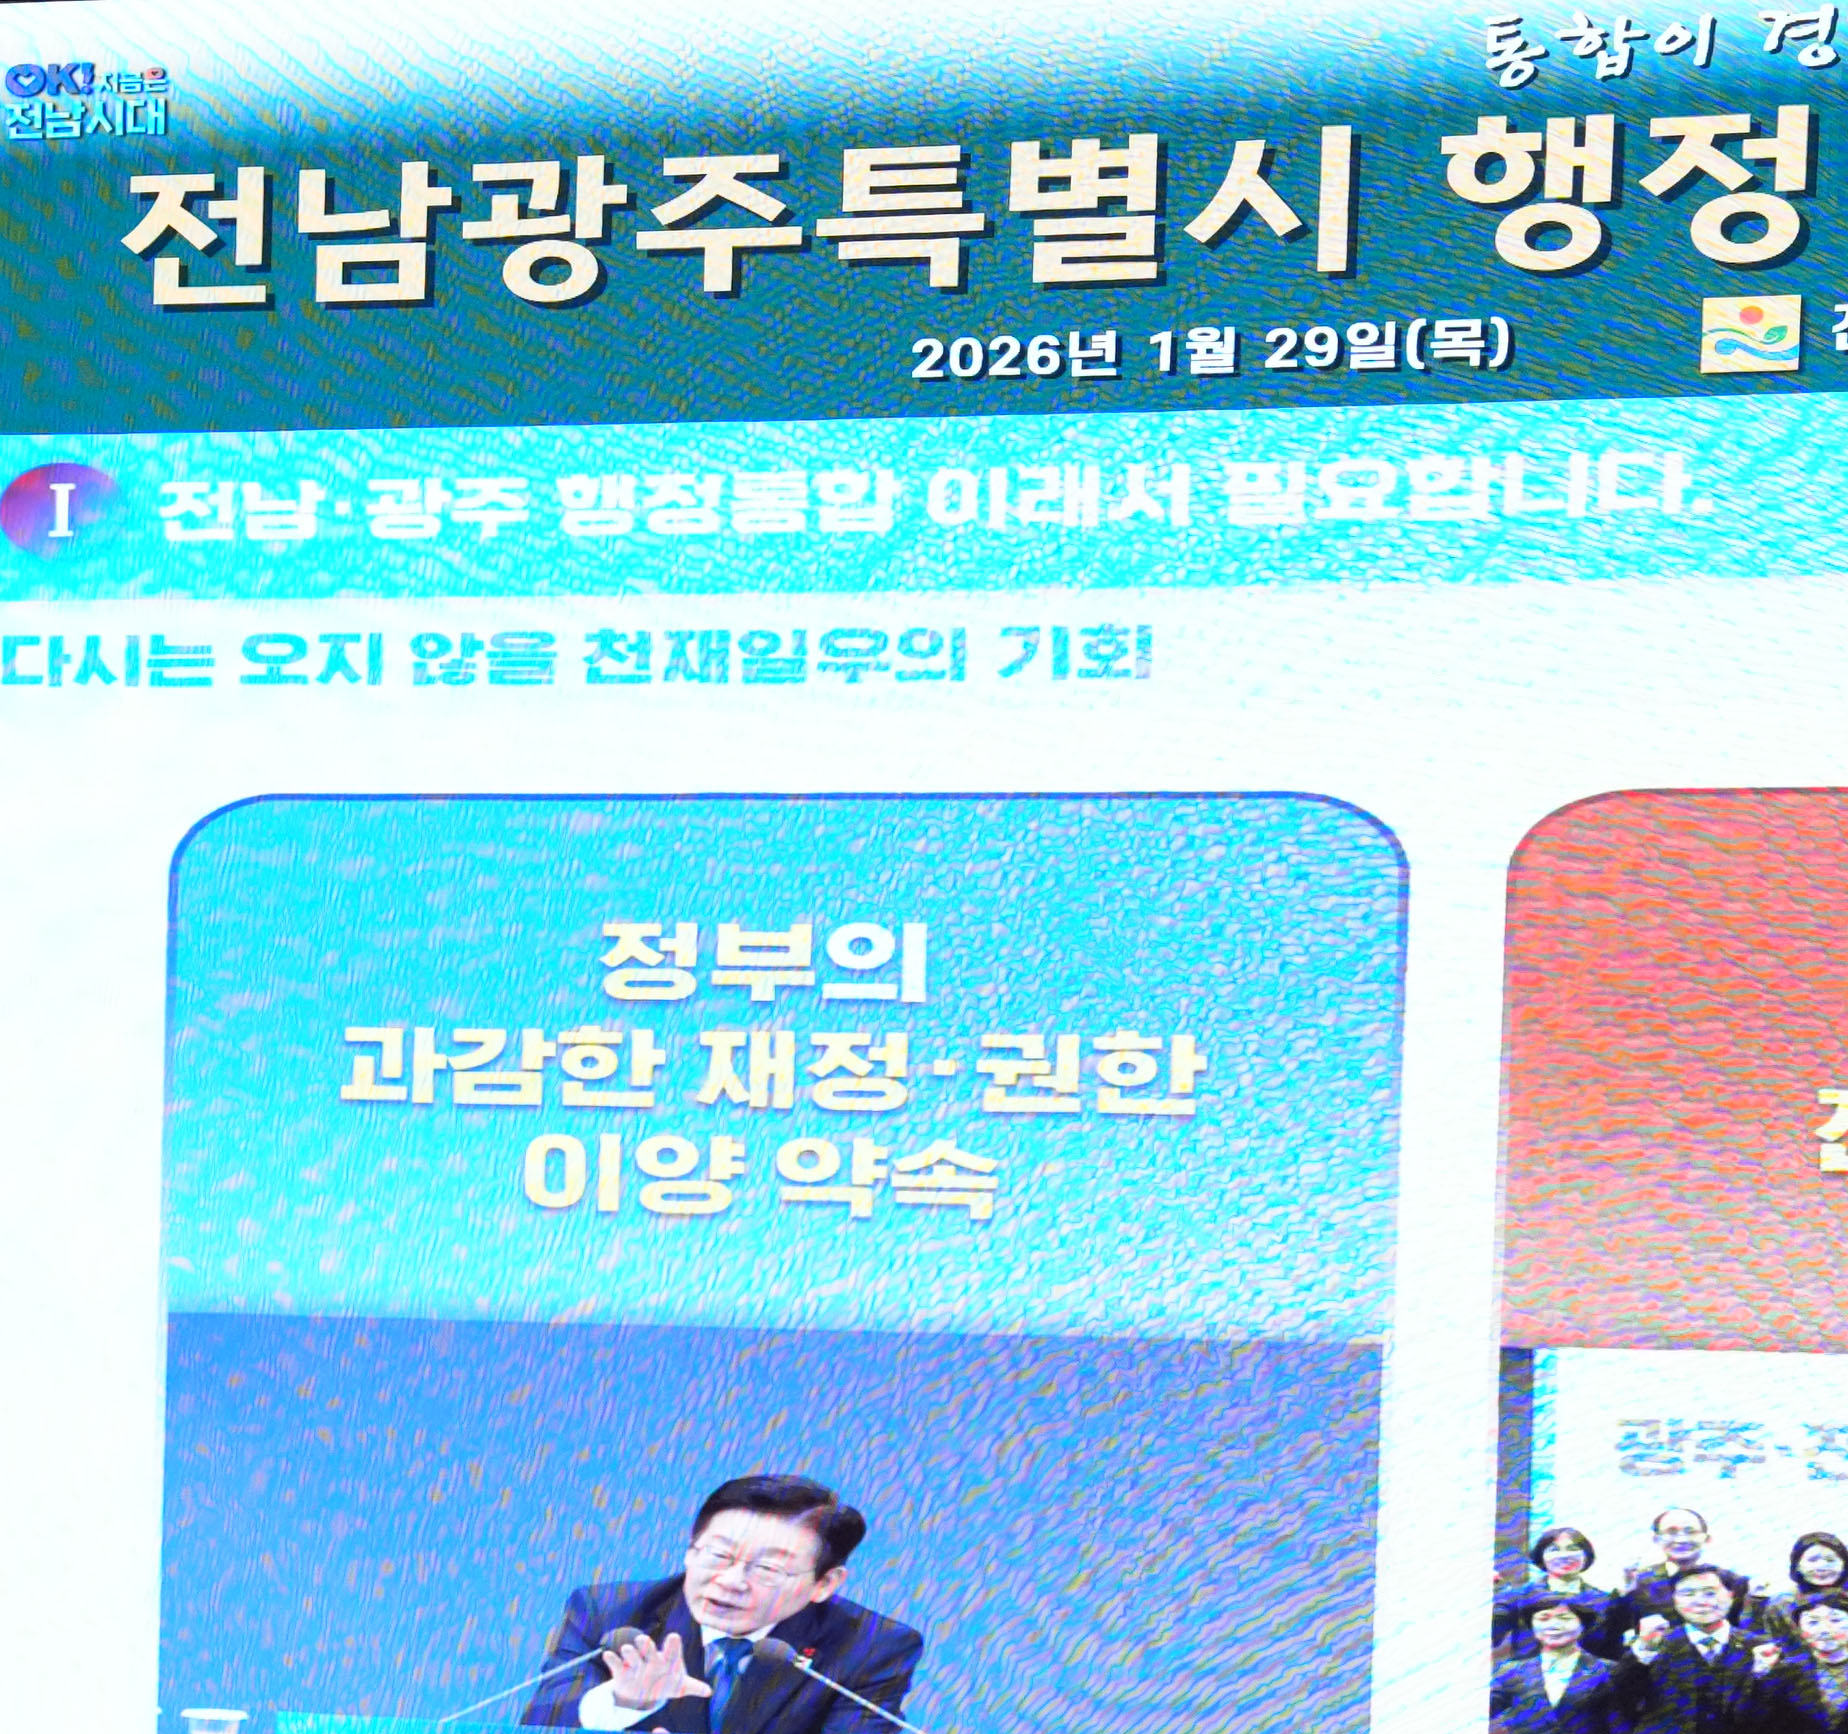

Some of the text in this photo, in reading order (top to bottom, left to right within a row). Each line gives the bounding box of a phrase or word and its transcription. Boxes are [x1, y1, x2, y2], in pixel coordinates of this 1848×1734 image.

[5, 62, 95, 97] OK!
[6, 99, 166, 139] 전남시대
[121, 123, 1356, 308] 전남광주특별시
[911, 315, 1512, 379] 2026년 1월 29일(목)
[158, 474, 531, 544] 전남·광주
[556, 470, 897, 537] 행정통합
[925, 463, 1192, 532] 이래서
[1222, 450, 1714, 526] 필요합니다.
[0, 622, 1153, 688] 다시는 오지 않을 천재일우의 기회
[598, 918, 930, 1006] 정부의
[338, 1026, 1209, 1116] 과감한 재정·권한
[522, 1130, 1000, 1221] 이양 약속
